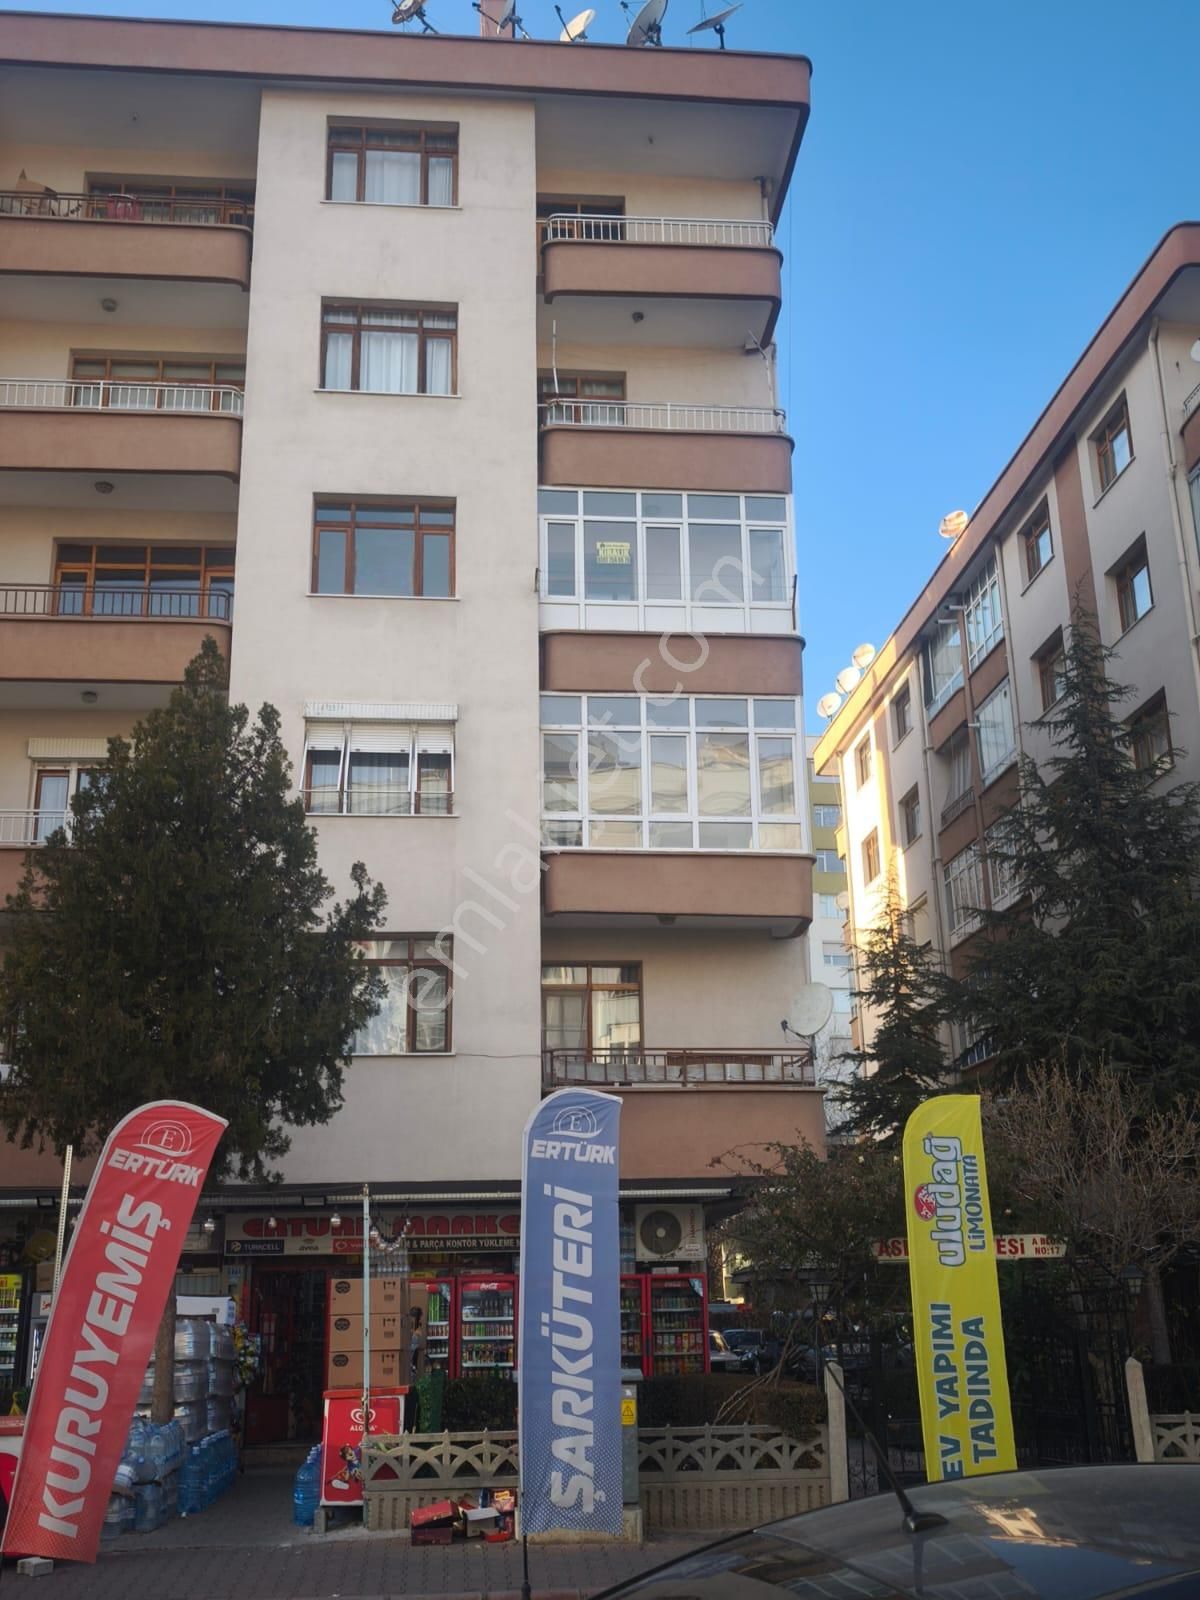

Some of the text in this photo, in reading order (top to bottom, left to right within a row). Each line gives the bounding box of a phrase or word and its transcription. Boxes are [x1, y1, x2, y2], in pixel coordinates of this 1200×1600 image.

[108, 1147, 204, 1187] ERTÜRK
[159, 1129, 176, 1149] E
[531, 1139, 616, 1164] ERTÜRK
[923, 1136, 966, 1267] uludağ
[420, 1240, 445, 1250] PARÇA
[1035, 1247, 1060, 1255] NO:17
[38, 1193, 171, 1539] KURUYEMİŞ
[541, 1184, 607, 1514] ŞARKÜTERİ
[961, 1316, 997, 1464] TADINDA
[930, 1303, 964, 1481] EV YAPIMI
